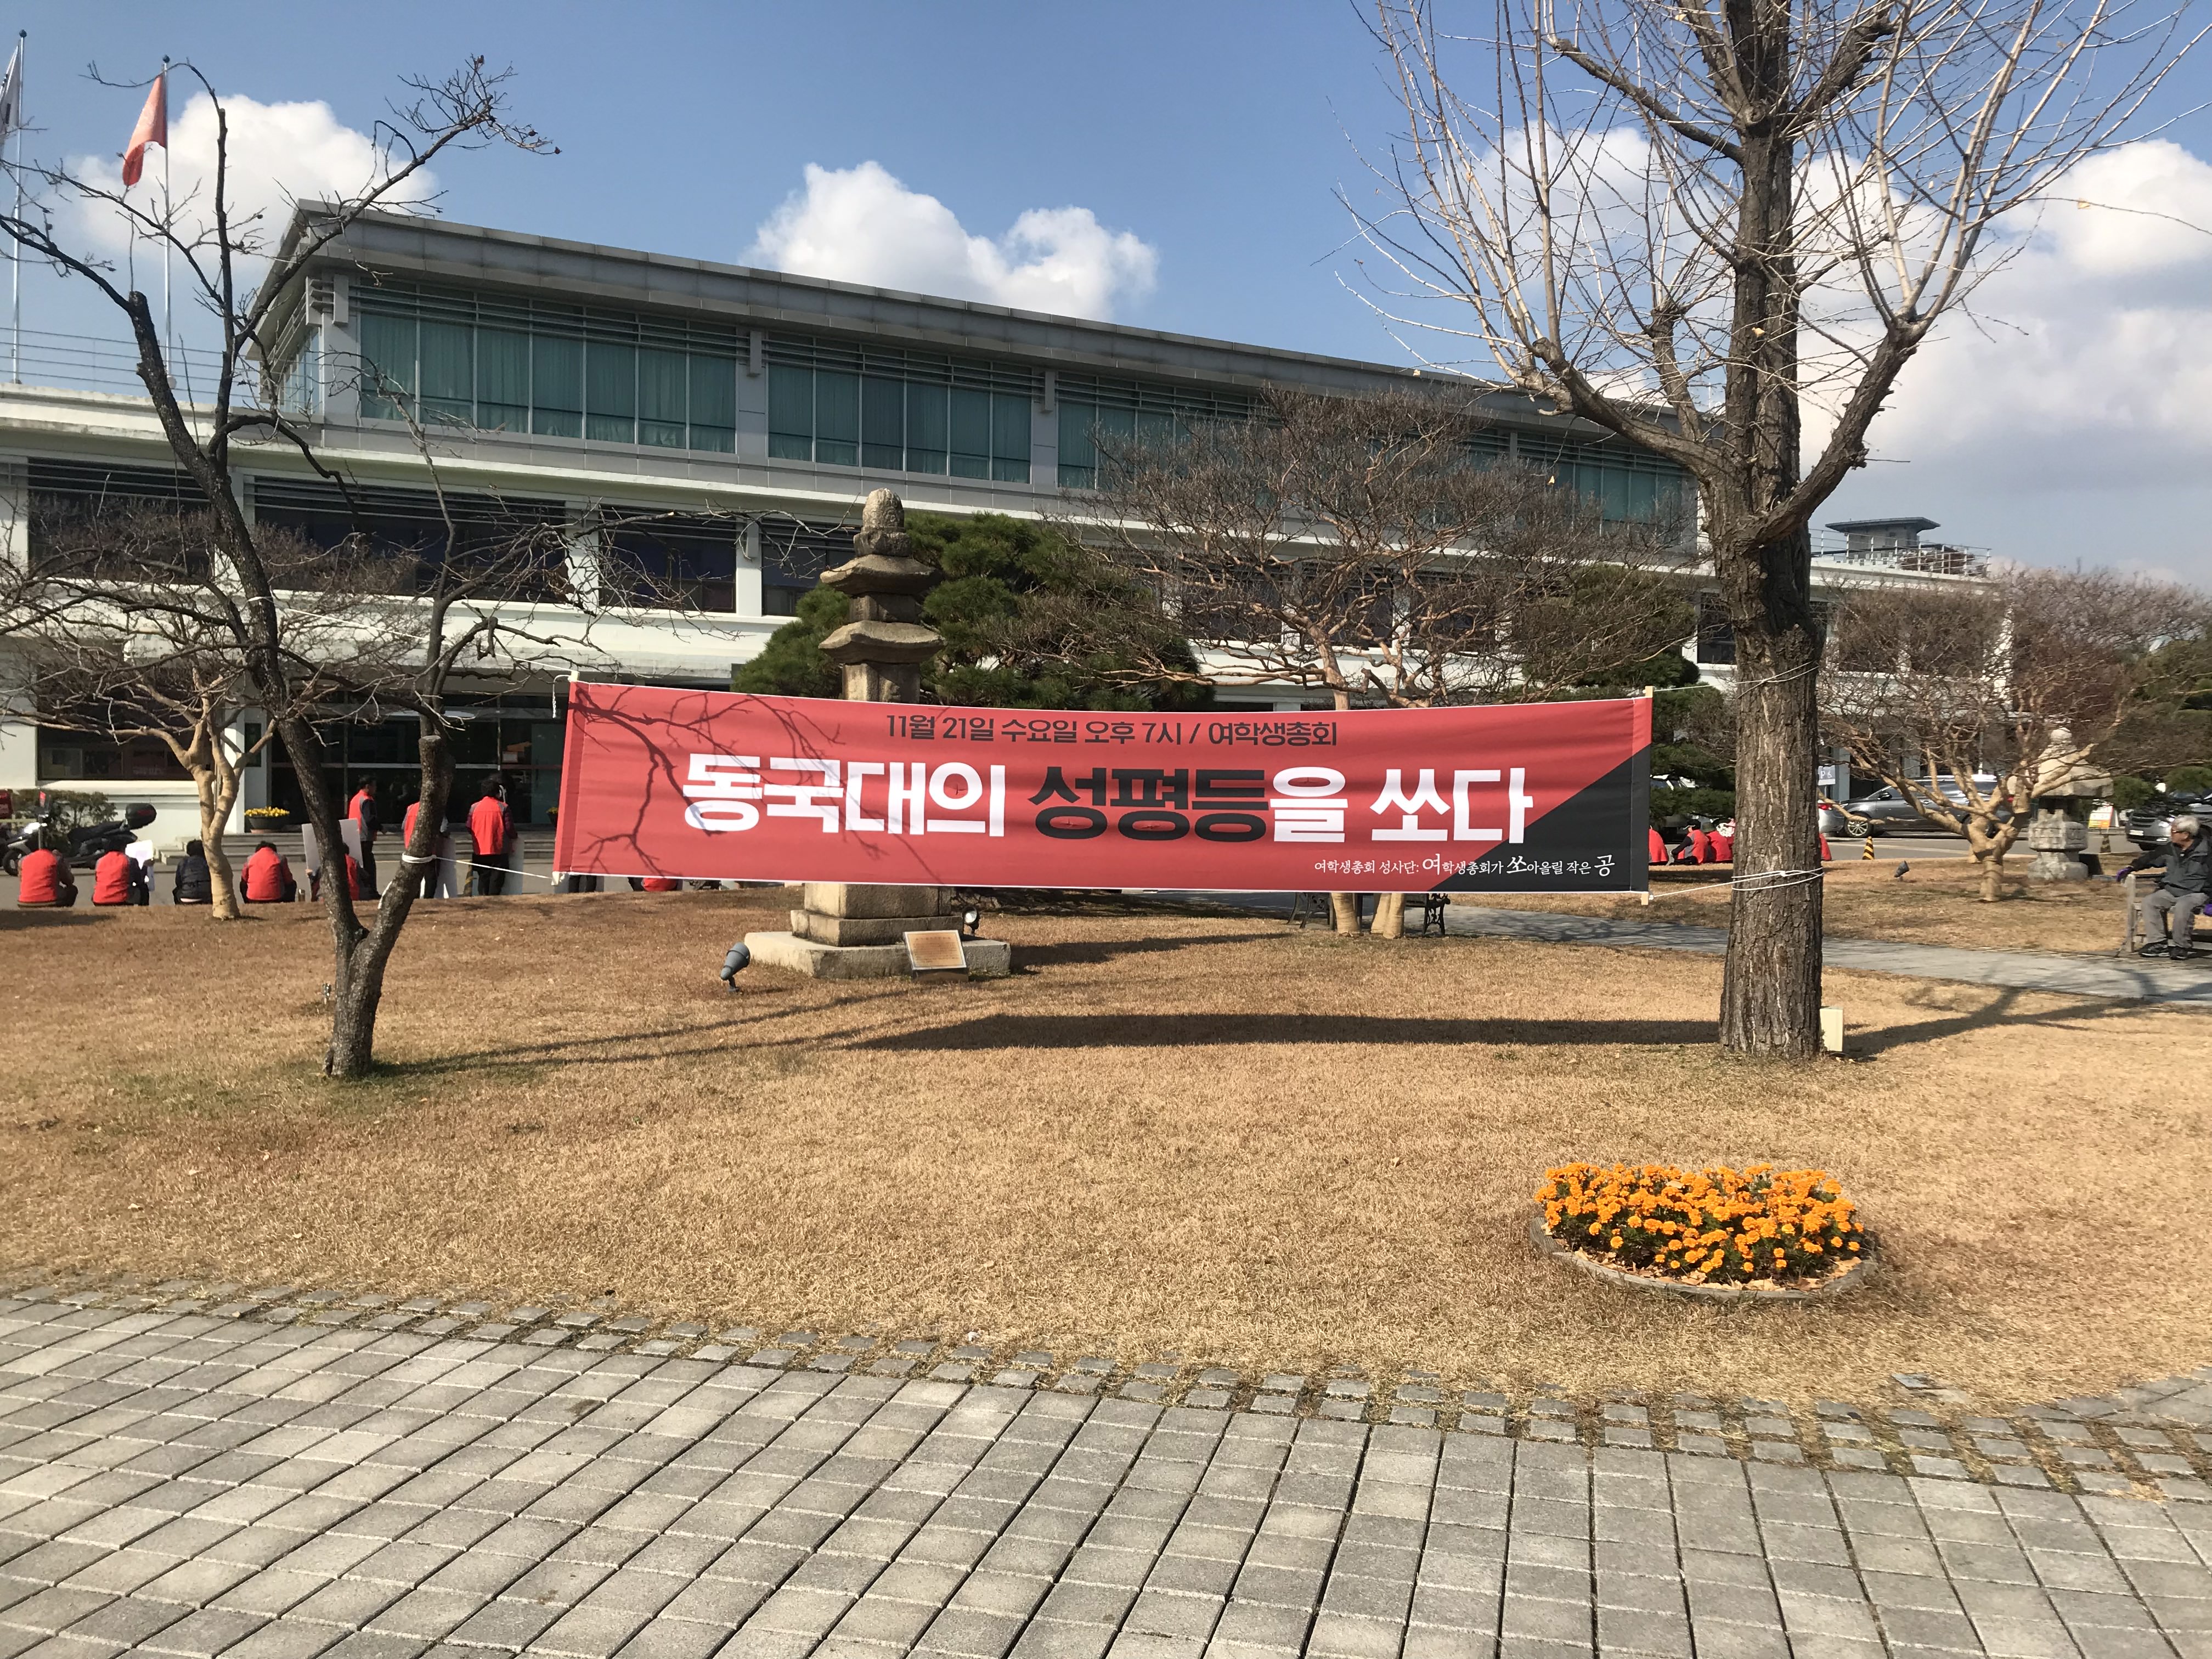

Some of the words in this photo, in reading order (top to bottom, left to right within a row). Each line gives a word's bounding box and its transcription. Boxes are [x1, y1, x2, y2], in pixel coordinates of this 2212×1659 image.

[887, 714, 935, 740] 11월
[942, 716, 995, 742] 21일
[1001, 719, 1077, 743] 수요일
[1084, 720, 1136, 744] 오후
[1141, 722, 1182, 746] 7시
[1208, 721, 1337, 747] 여학생총회
[682, 753, 1006, 837] 동국대의
[1027, 766, 1349, 843] 성평등을
[1369, 766, 1534, 844] 쏘다
[1314, 859, 1375, 874] 여학생총회
[1379, 860, 1419, 874] 성사단:
[1422, 853, 1504, 876] 여학생총회가
[1506, 855, 1564, 875] 쏘아올릴
[1566, 860, 1592, 875] 작은
[1593, 854, 1616, 877] 공
